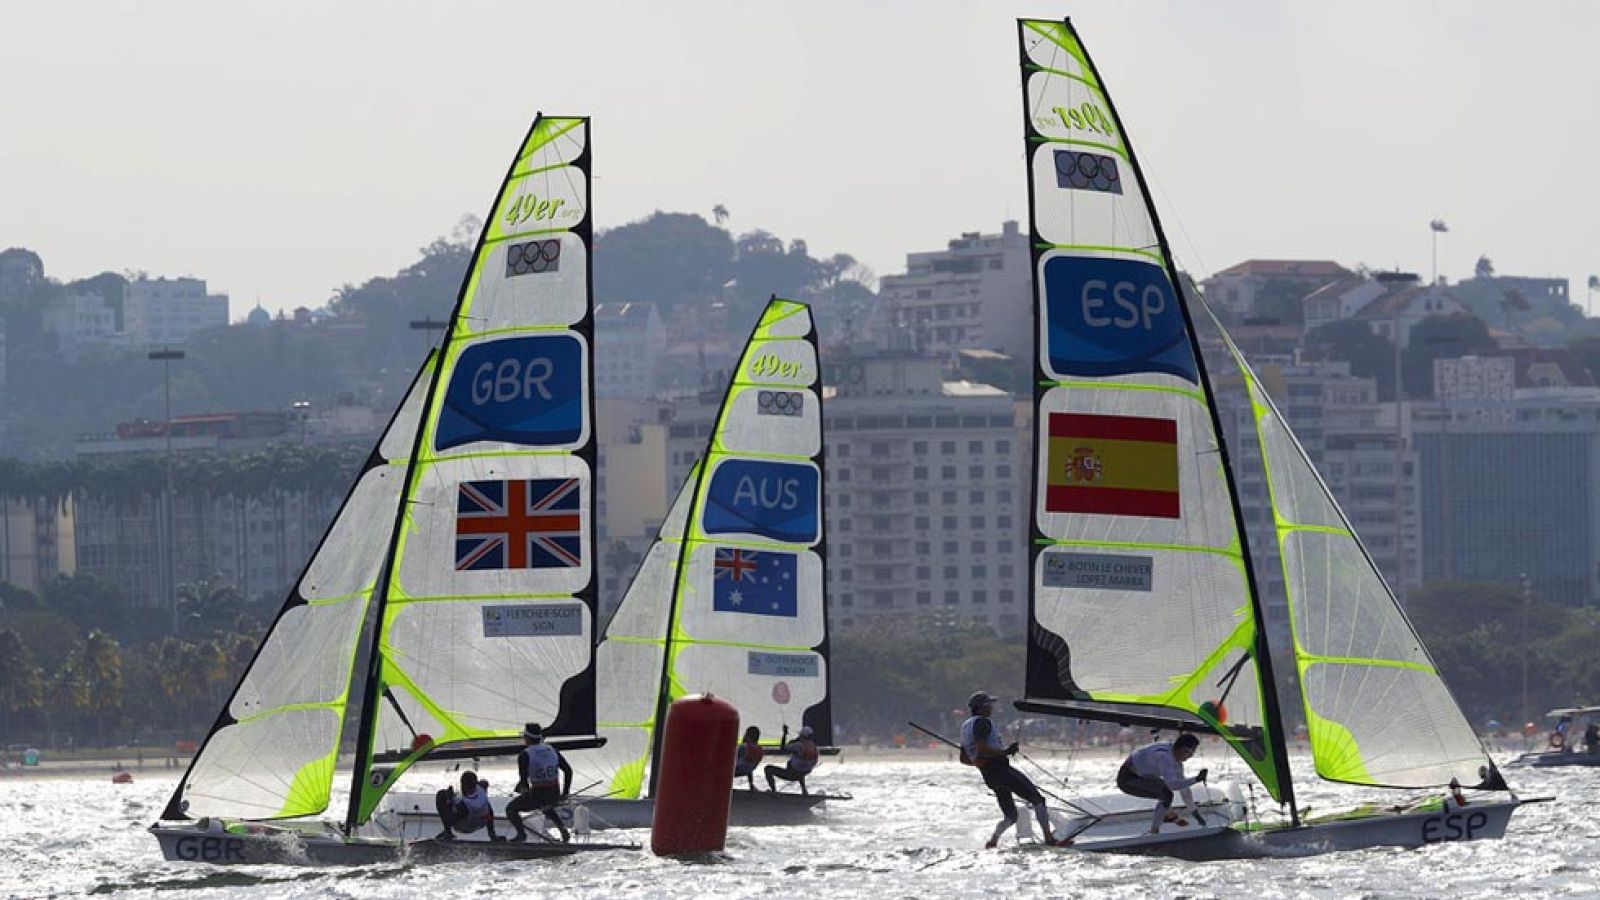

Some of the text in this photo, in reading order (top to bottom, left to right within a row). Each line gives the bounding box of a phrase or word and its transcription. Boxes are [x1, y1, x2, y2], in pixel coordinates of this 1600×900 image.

[505, 193, 565, 225] 49er
[1082, 279, 1165, 330] ESP
[471, 357, 554, 406] GBR
[752, 354, 802, 378] 49er
[732, 474, 799, 511] AUS
[1422, 811, 1487, 843] ESP
[175, 836, 246, 861] GBR
